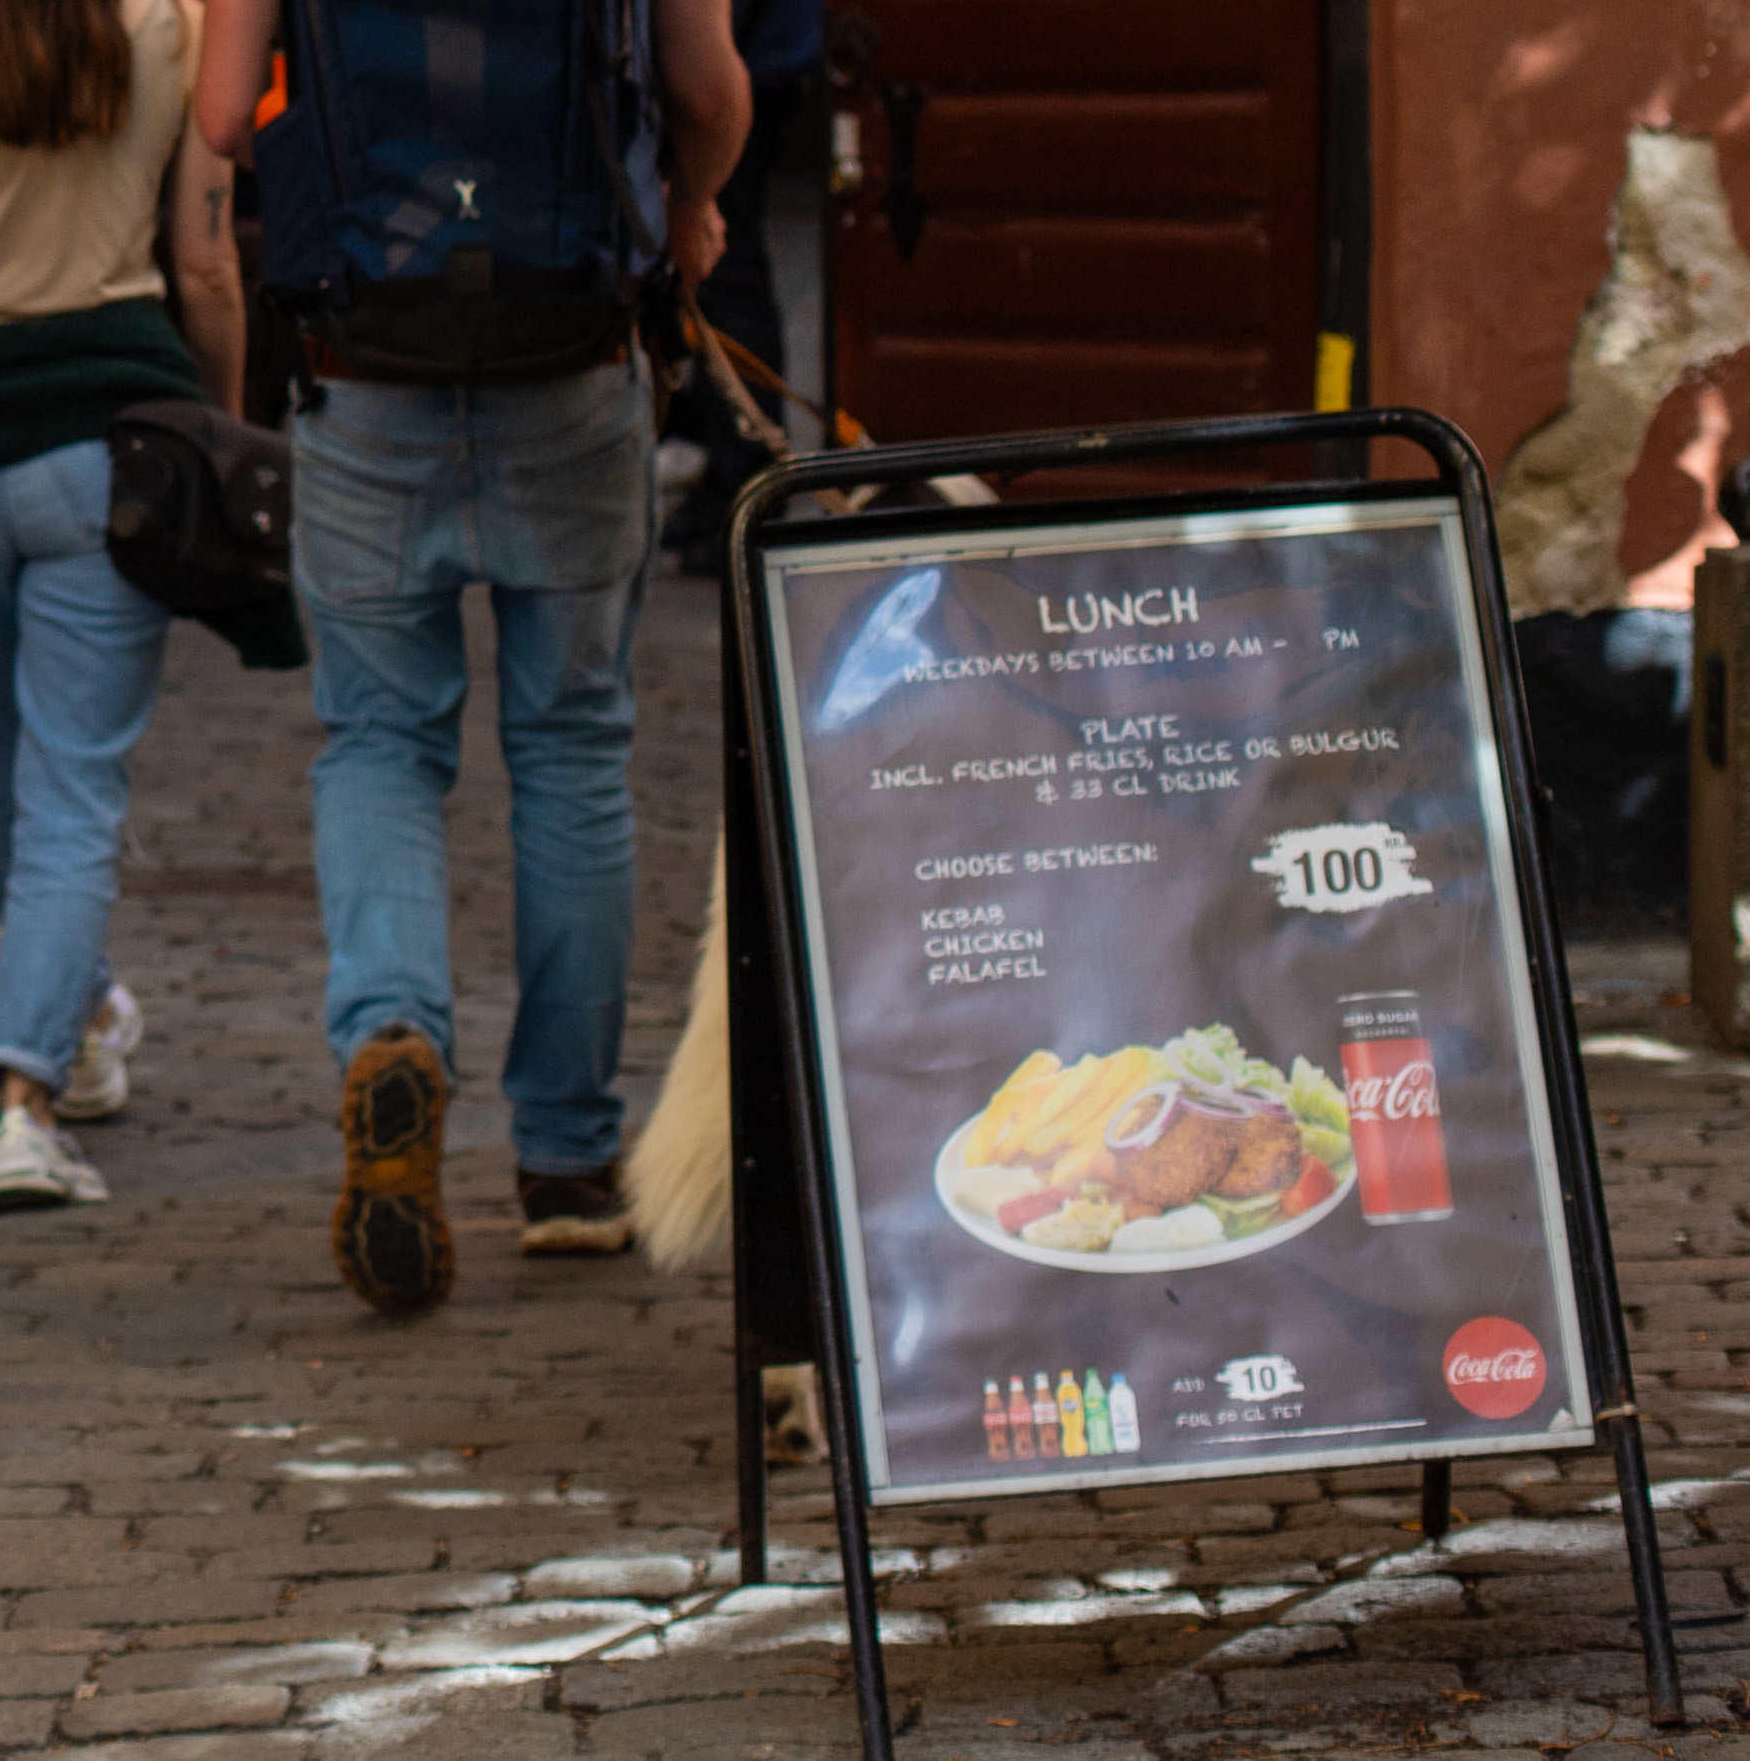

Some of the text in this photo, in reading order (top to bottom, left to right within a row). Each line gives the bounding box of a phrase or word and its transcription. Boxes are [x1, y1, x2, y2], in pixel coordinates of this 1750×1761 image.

[1038, 586, 1200, 633] LUNCH
[904, 650, 1041, 683] WEEKDAYS
[1049, 642, 1175, 672] BETWEEN
[1185, 641, 1217, 661] 10
[1224, 636, 1264, 658] AM
[1322, 626, 1361, 650] PM
[1081, 714, 1181, 745] PLATE
[870, 727, 1400, 789] INCL. FRENCH FRIES, RICE OR BULGUR
[1069, 778, 1103, 800] 33
[1112, 774, 1149, 796] CL
[1159, 767, 1241, 794] DRINK
[914, 842, 1159, 881] CHOOSE BETWEEN:
[1293, 847, 1383, 895] 100
[920, 903, 1005, 931] KEBAB
[923, 929, 1045, 958] CHICKEN
[927, 956, 1048, 985] FALAFEL
[1243, 1366, 1277, 1393] 10
[1244, 1407, 1266, 1421] CL
